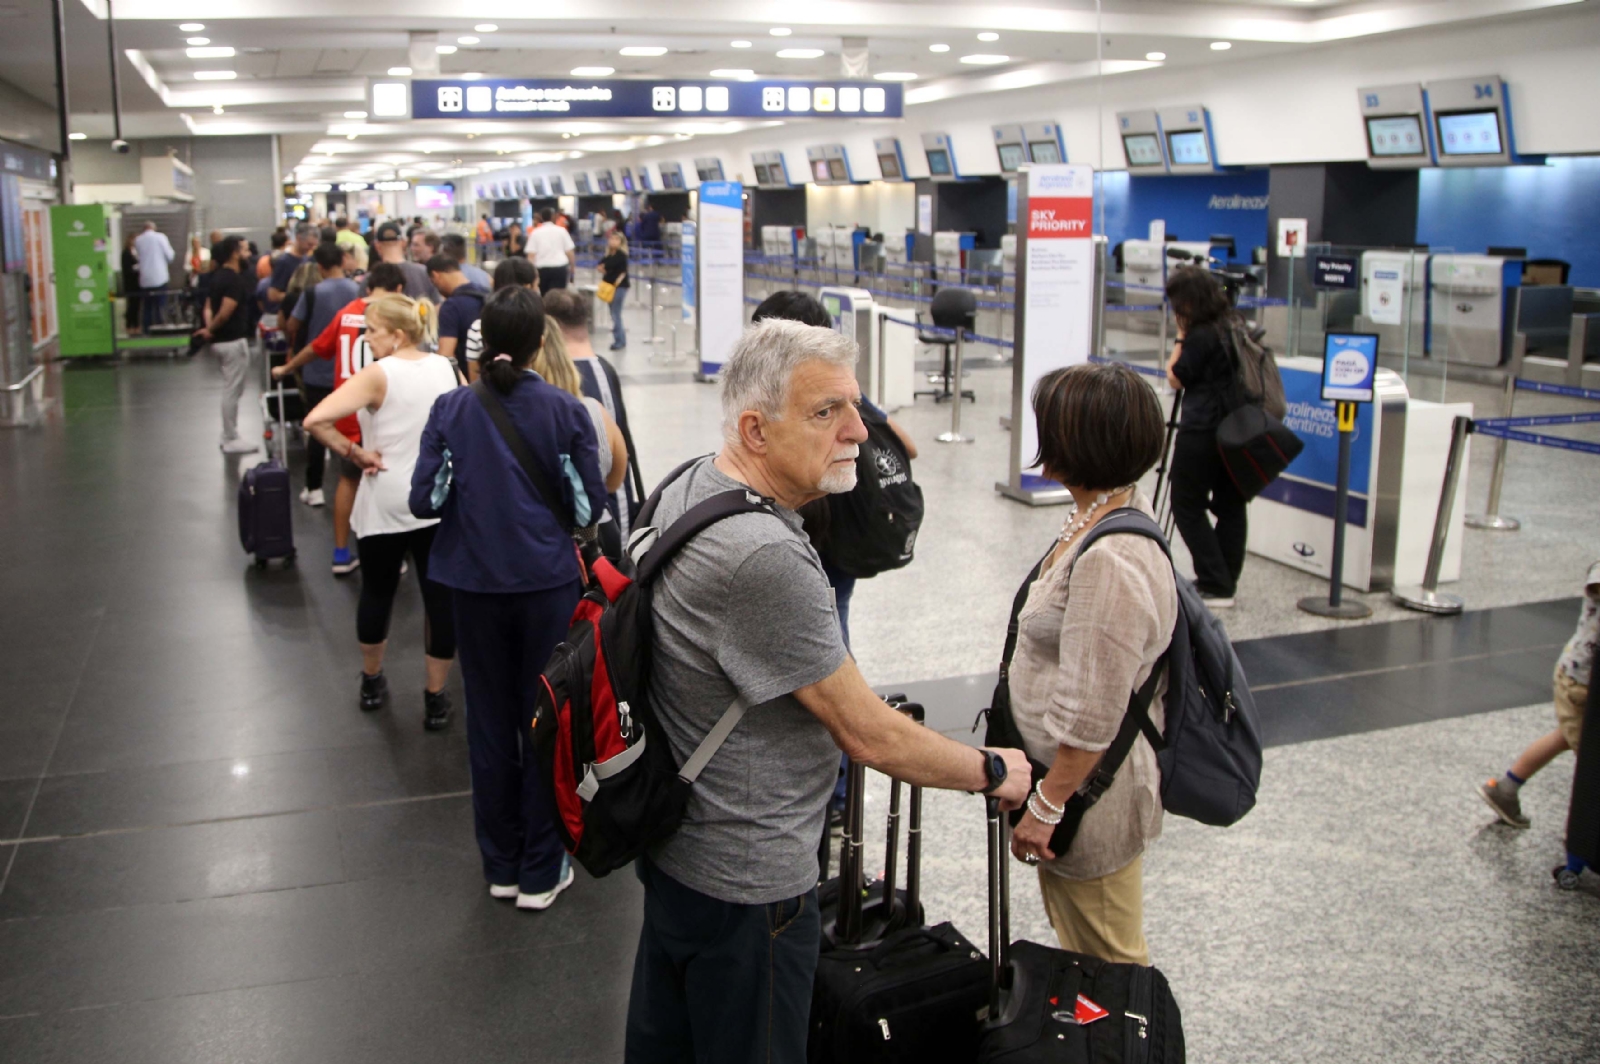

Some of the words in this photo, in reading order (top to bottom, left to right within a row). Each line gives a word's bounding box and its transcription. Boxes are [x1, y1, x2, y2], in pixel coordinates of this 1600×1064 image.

[1474, 84, 1493, 99] 34
[1031, 210, 1056, 220] SKY
[1030, 220, 1086, 231] PRIORITY
[1331, 262, 1352, 273] Priority
[341, 334, 374, 379] 10
[1282, 416, 1334, 438] gentinas
